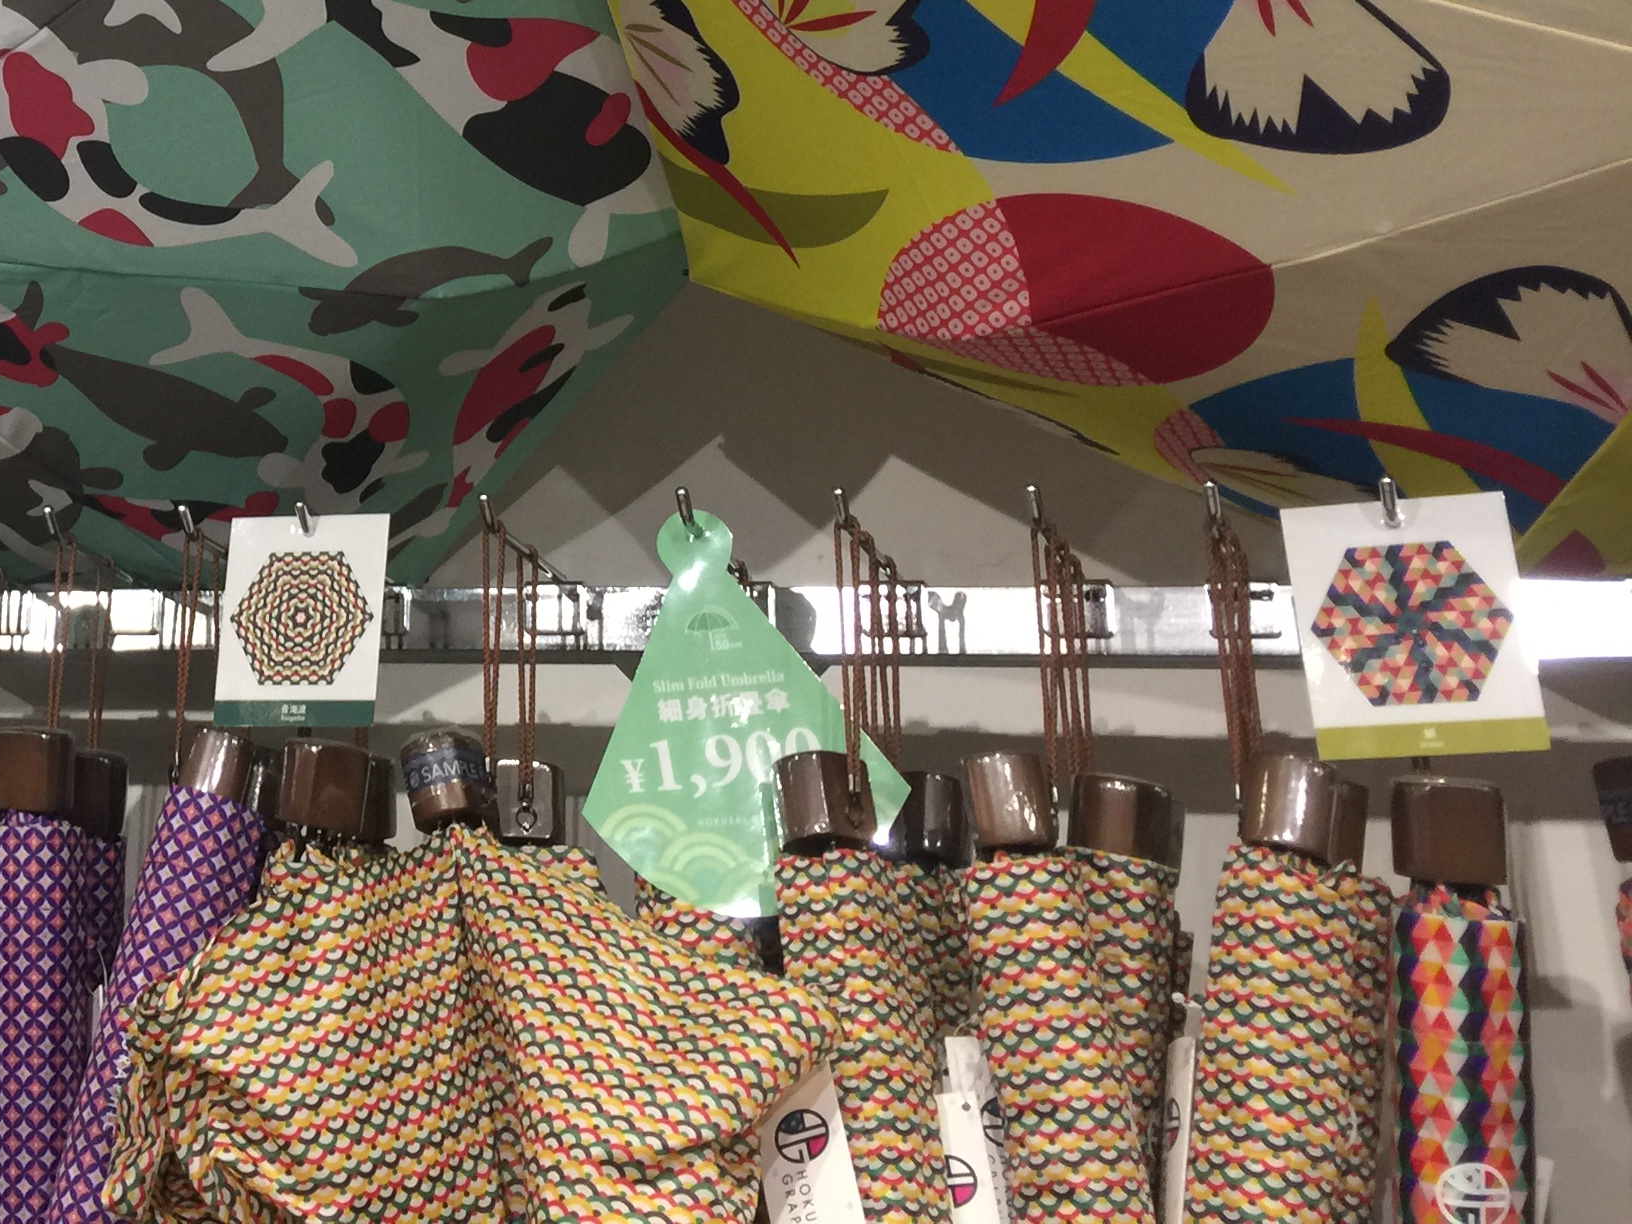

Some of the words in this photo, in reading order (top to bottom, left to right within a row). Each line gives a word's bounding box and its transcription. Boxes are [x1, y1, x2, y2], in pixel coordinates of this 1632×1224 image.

[652, 679, 685, 693] Slim
[688, 677, 717, 690] Fold
[720, 670, 785, 686] Umbrella
